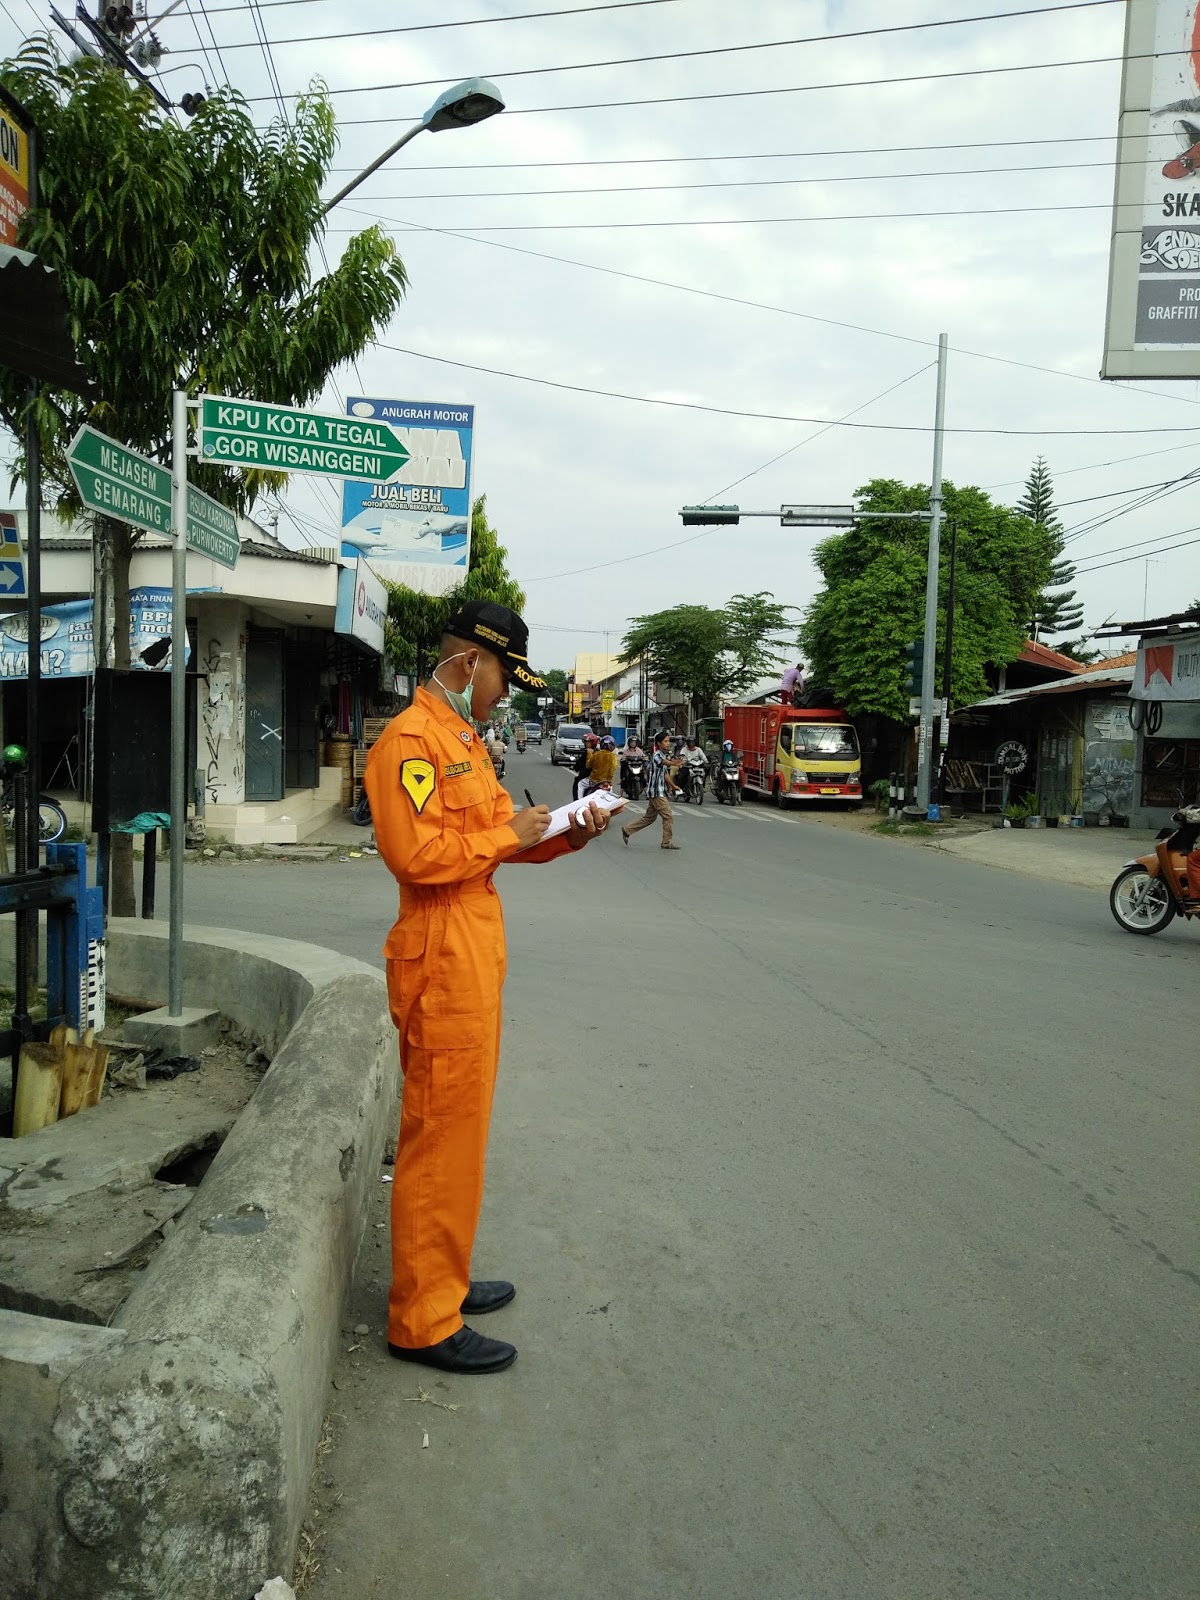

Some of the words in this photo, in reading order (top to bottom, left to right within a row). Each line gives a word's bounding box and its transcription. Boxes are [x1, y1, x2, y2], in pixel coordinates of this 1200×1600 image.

[1148, 306, 1198, 320] GRAFFITI
[218, 406, 260, 429] KPU
[266, 413, 319, 438] KOTA
[324, 421, 387, 448] TEGAL
[381, 407, 431, 419] ANUGRAH
[433, 410, 468, 422] MOTOR
[100, 446, 157, 491] MEJASEM
[215, 436, 258, 458] GOR
[264, 442, 381, 475] WISANGGENI
[94, 478, 162, 525] SEMARANG
[361, 500, 383, 508] MOTOR
[389, 502, 409, 510] MOBIL
[409, 503, 428, 511] BEKAS
[432, 504, 449, 513] BARU
[370, 485, 407, 502] JUAL
[410, 487, 442, 504] BELI
[189, 494, 207, 518] RSUD
[206, 503, 235, 536] KARDINAH
[191, 524, 234, 561] PURWOKERTO
